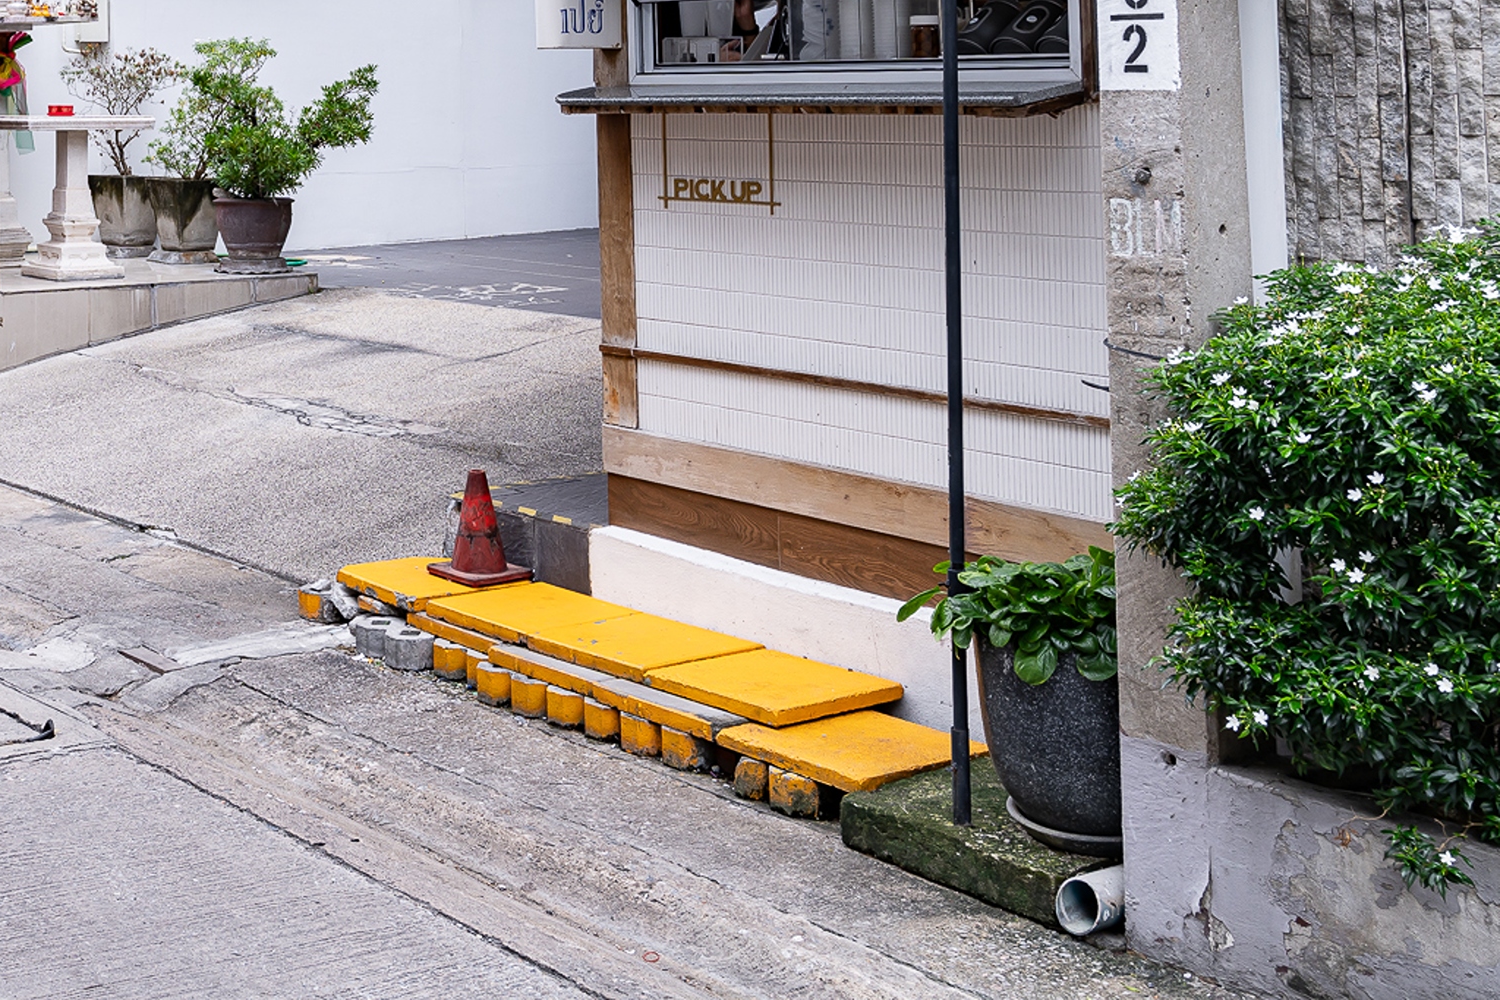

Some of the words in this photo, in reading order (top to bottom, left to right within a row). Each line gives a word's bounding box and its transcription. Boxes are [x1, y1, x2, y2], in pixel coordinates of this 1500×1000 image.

[1122, 24, 1148, 74] 2
[673, 178, 728, 201] PICK
[730, 180, 763, 203] UP
